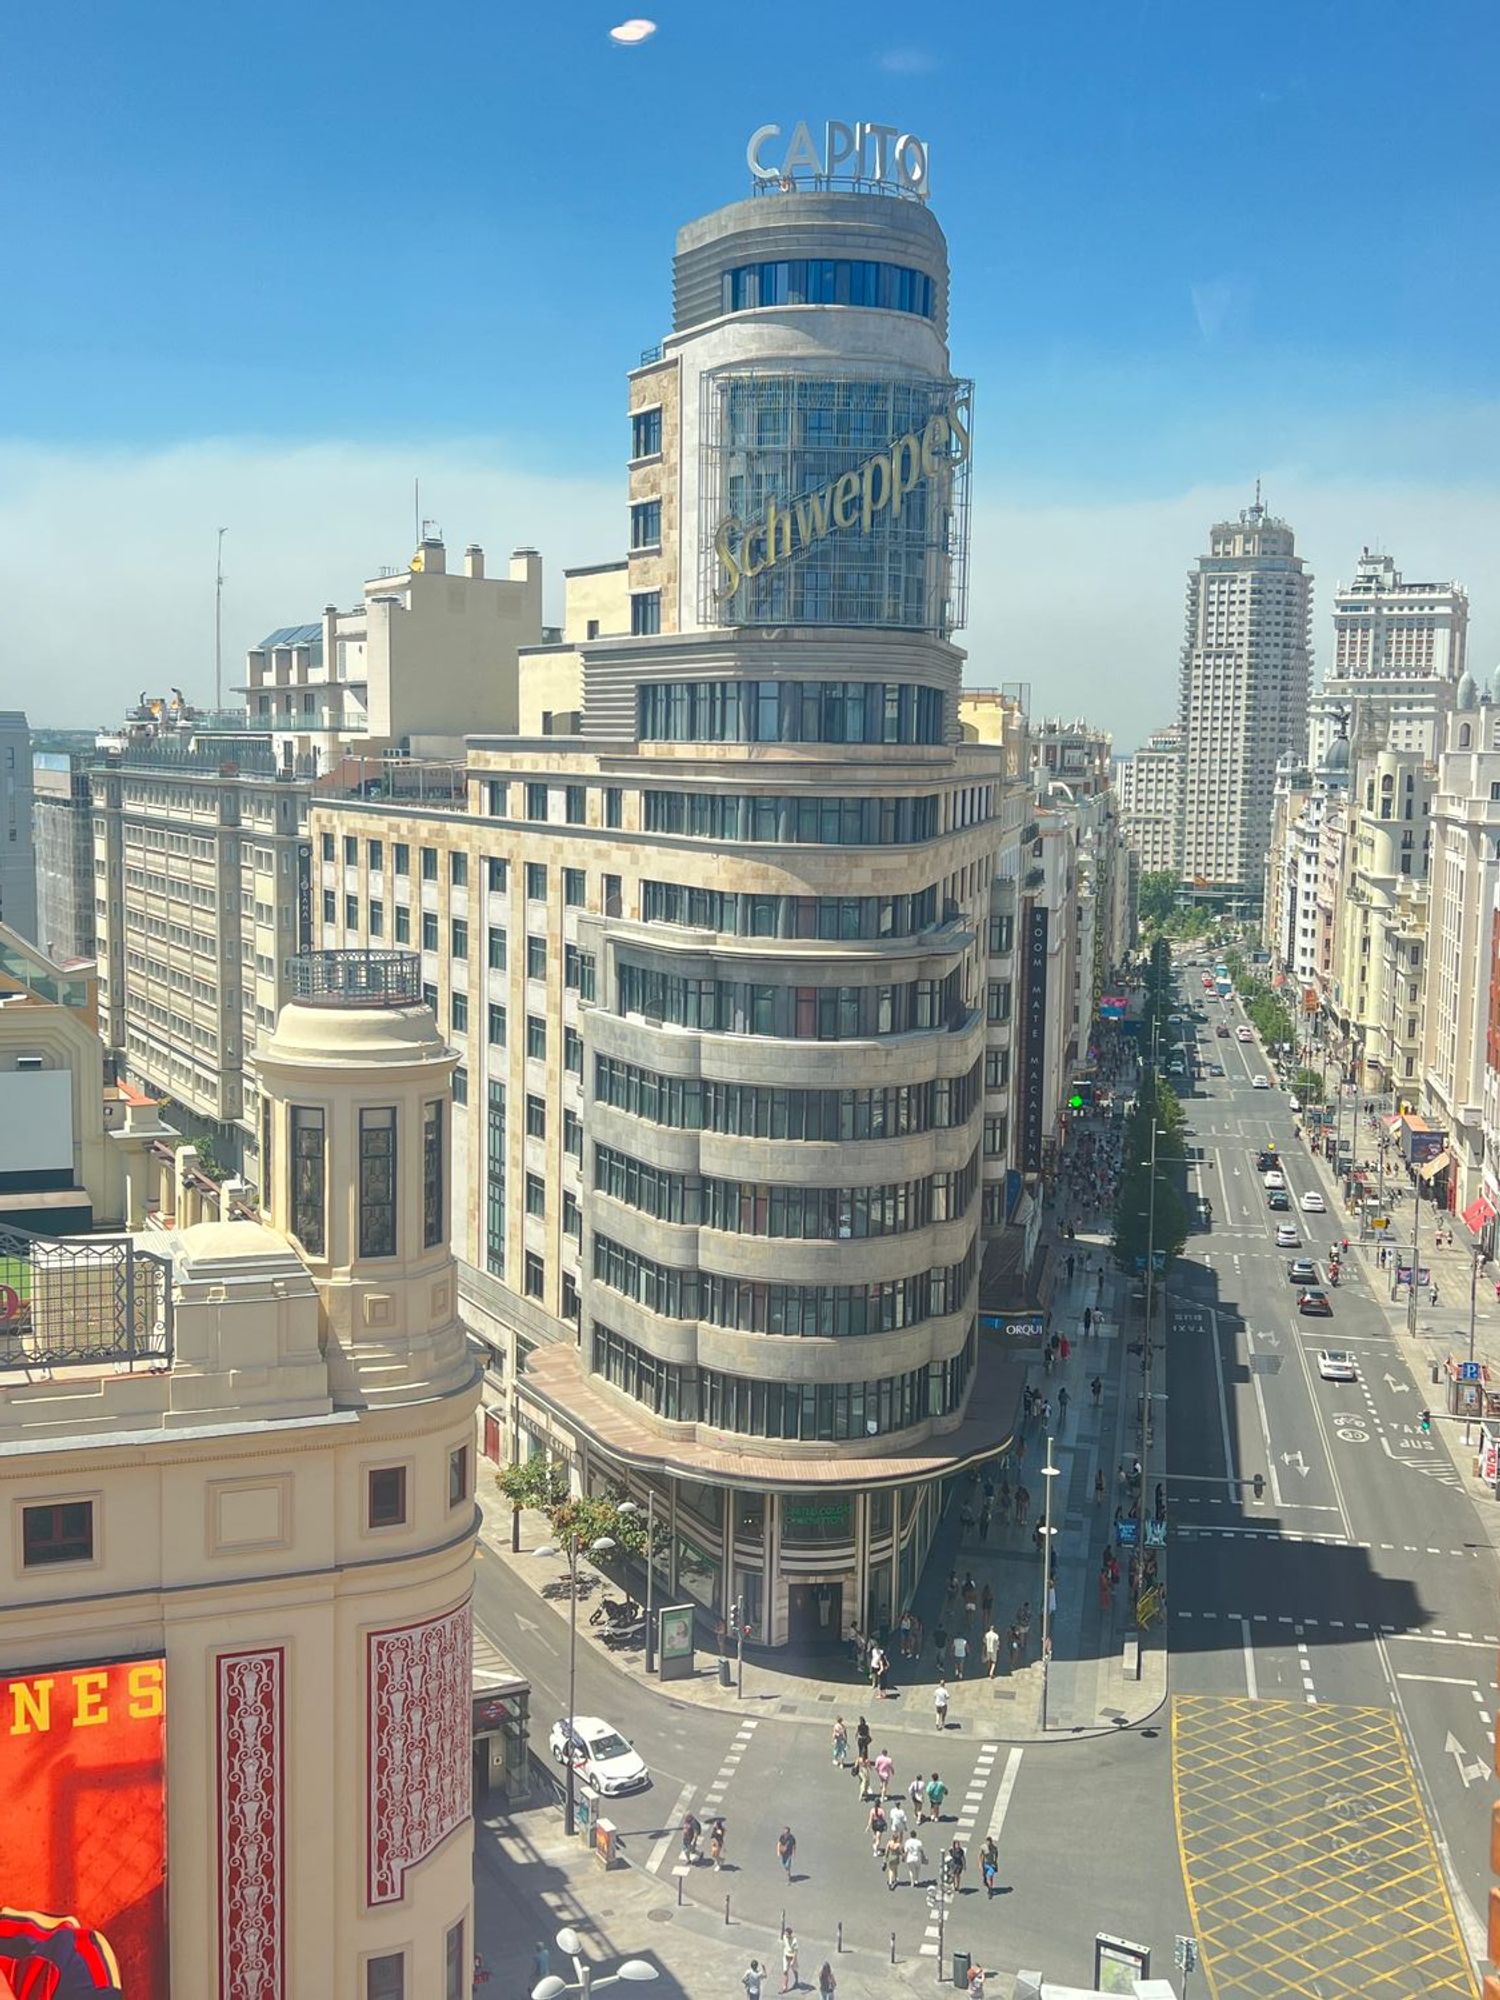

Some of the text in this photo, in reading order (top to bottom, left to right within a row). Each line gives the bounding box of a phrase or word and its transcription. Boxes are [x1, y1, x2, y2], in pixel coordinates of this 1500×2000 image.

[714, 397, 971, 602] Schweppes
[1028, 913, 1043, 1167] ROOM MATE MACARENA
[1006, 1325, 1042, 1336] ORQUI
[9, 1666, 163, 1736] NES
